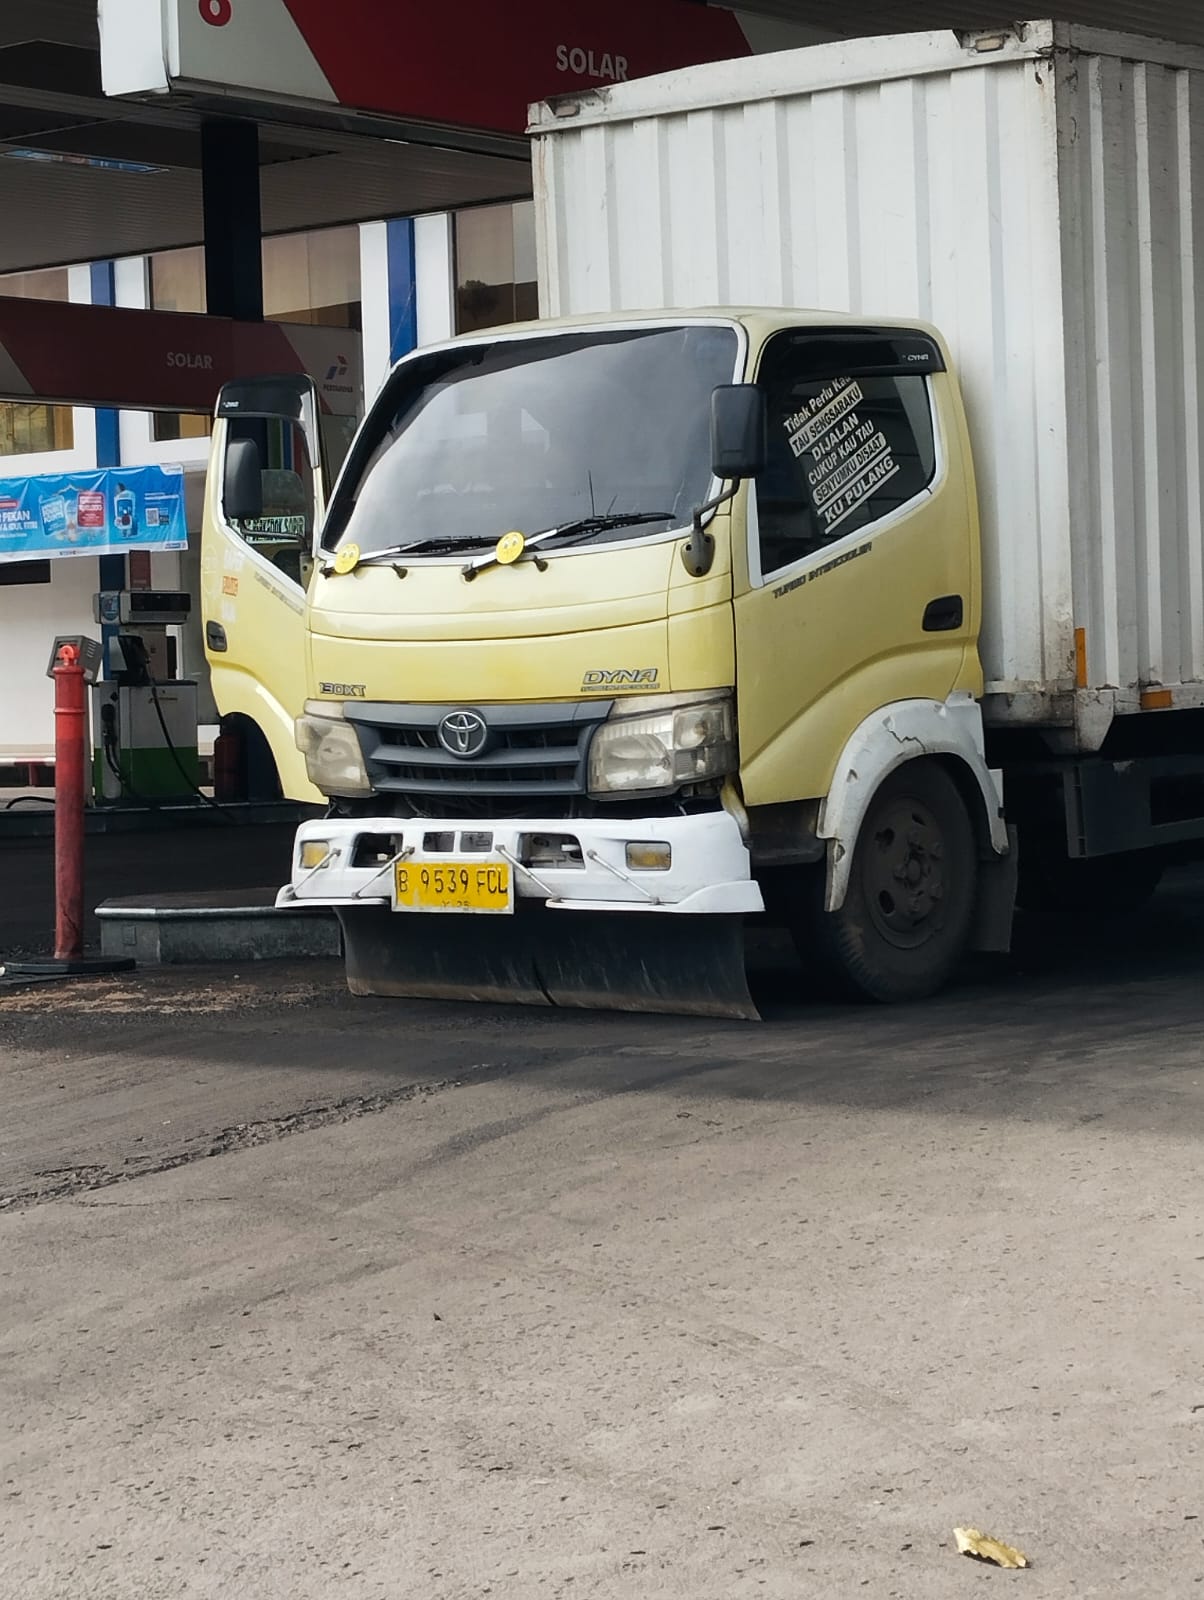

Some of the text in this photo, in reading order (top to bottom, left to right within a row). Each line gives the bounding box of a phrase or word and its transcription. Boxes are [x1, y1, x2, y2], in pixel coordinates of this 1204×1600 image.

[556, 44, 629, 82] SOLAR
[166, 351, 214, 369] SOLAR
[783, 406, 811, 433] Tidak
[808, 387, 834, 413] Perlu
[791, 386, 861, 453] TAU SENGSARAKU
[808, 420, 874, 485] CUKUP KAU TAU
[811, 412, 859, 461] DIJALAN
[815, 435, 882, 501] SENYUMKU DISAAT
[824, 455, 894, 523] KU PULANG
[582, 668, 658, 685] DYNA
[398, 867, 509, 895] B 9539 FCL
